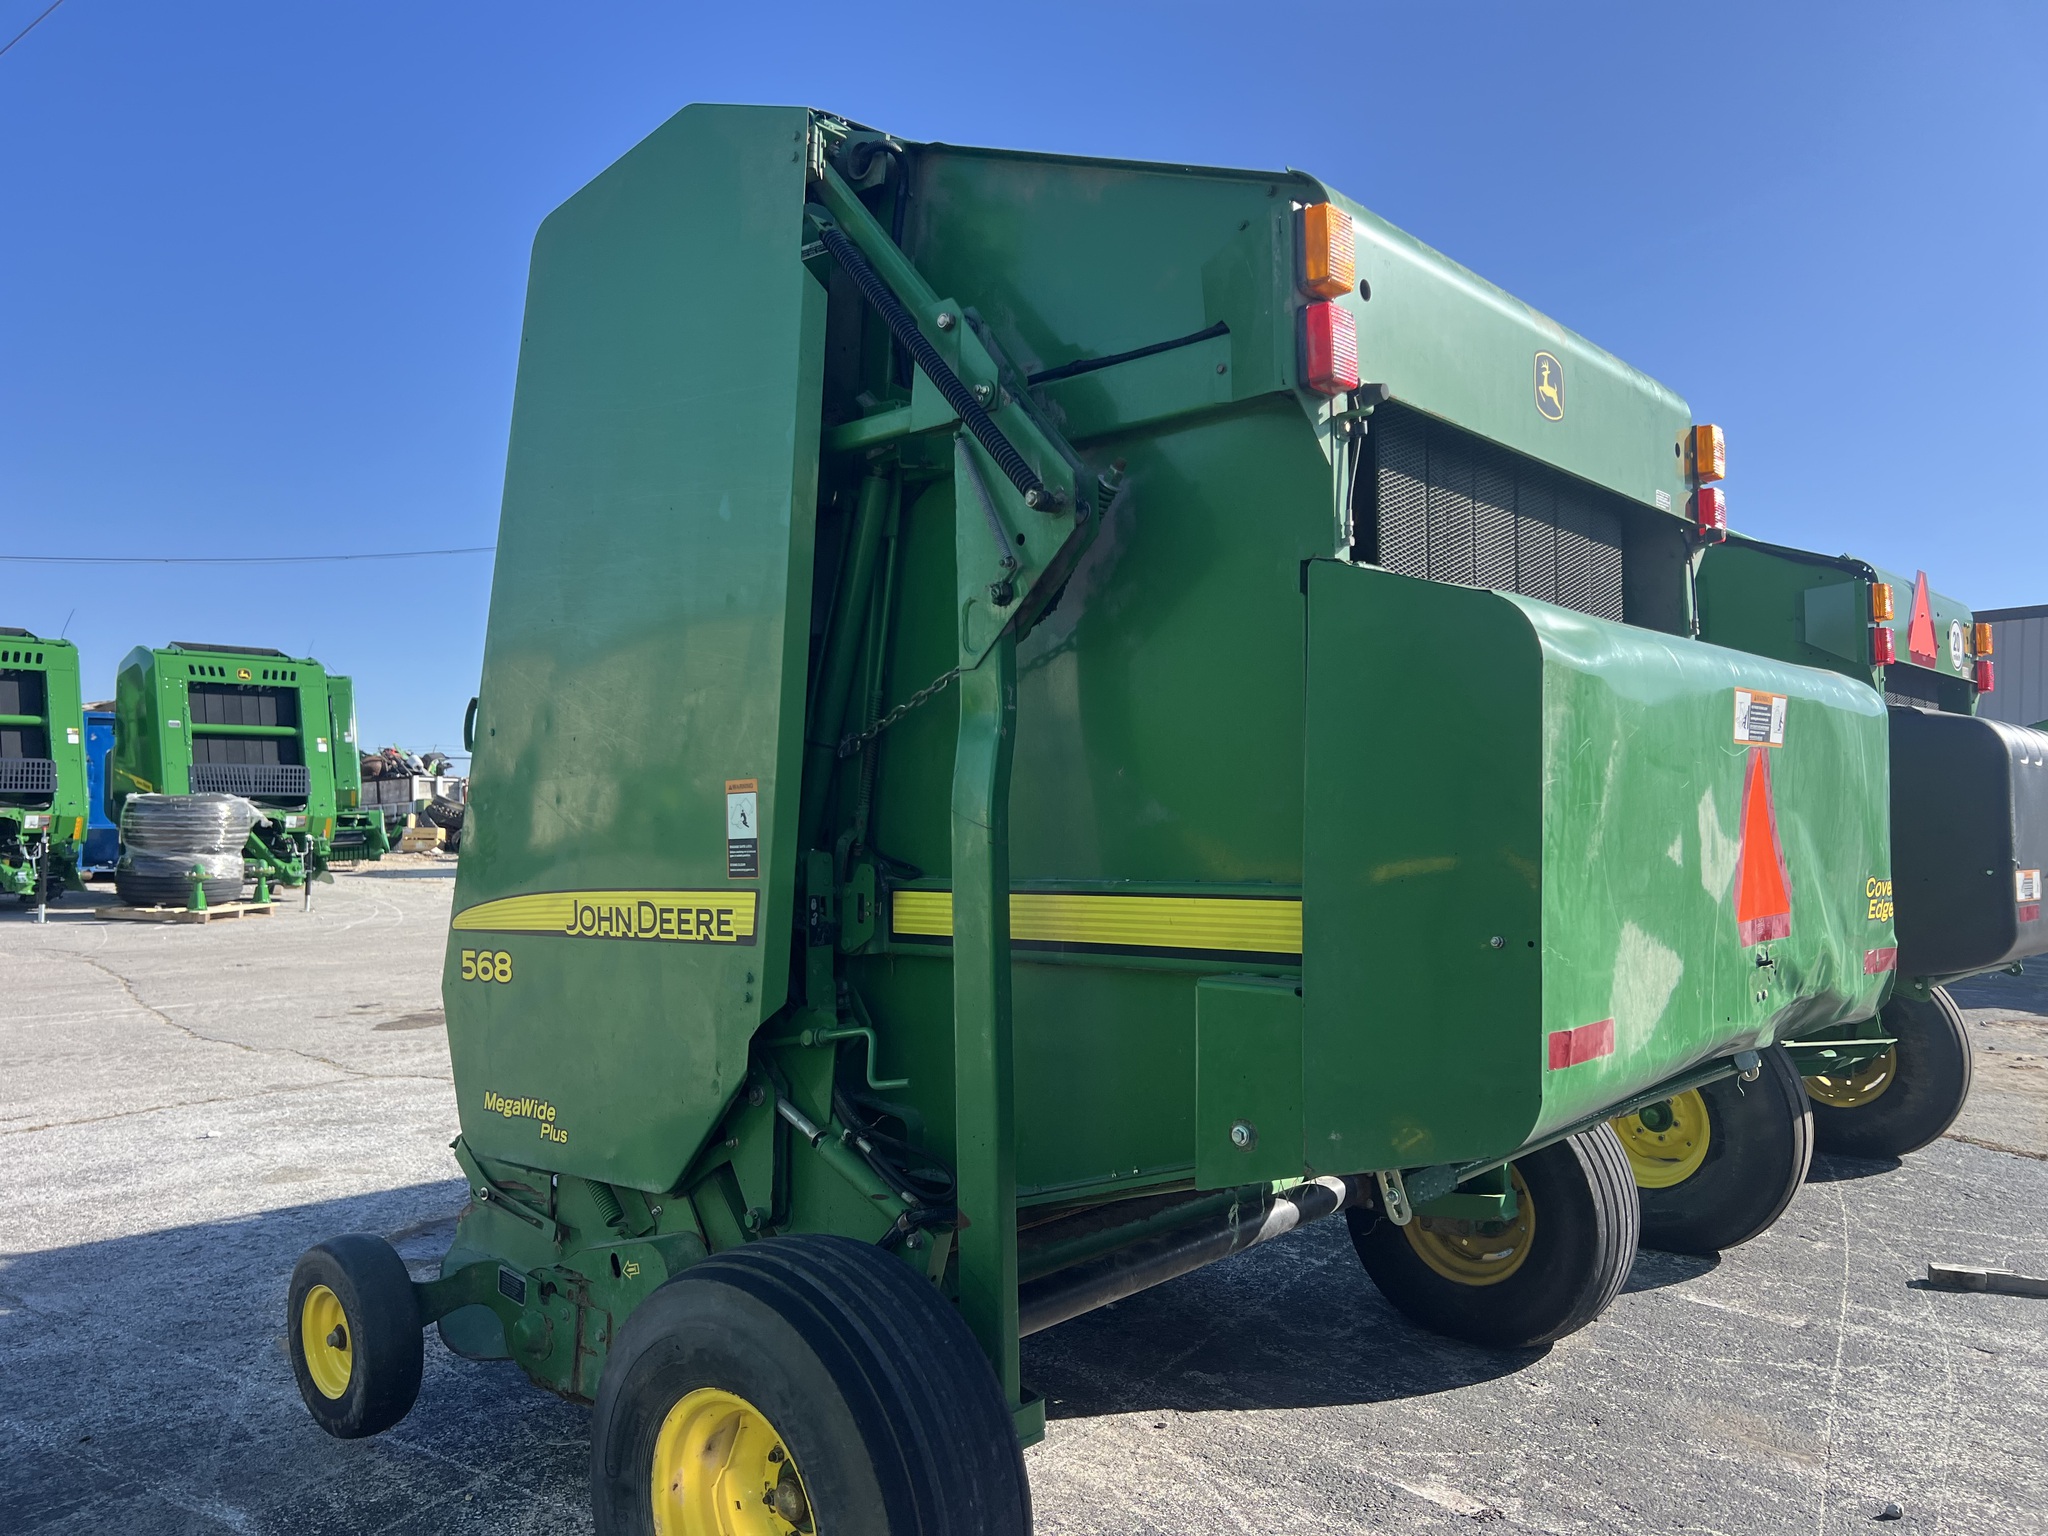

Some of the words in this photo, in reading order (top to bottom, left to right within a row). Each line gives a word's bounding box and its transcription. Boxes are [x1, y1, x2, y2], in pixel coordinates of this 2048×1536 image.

[1866, 877, 1892, 898] Cove
[1868, 898, 1893, 922] Edge
[461, 949, 513, 984] 568
[483, 1090, 557, 1123] MegaWide
[540, 1122, 569, 1144] Plus
